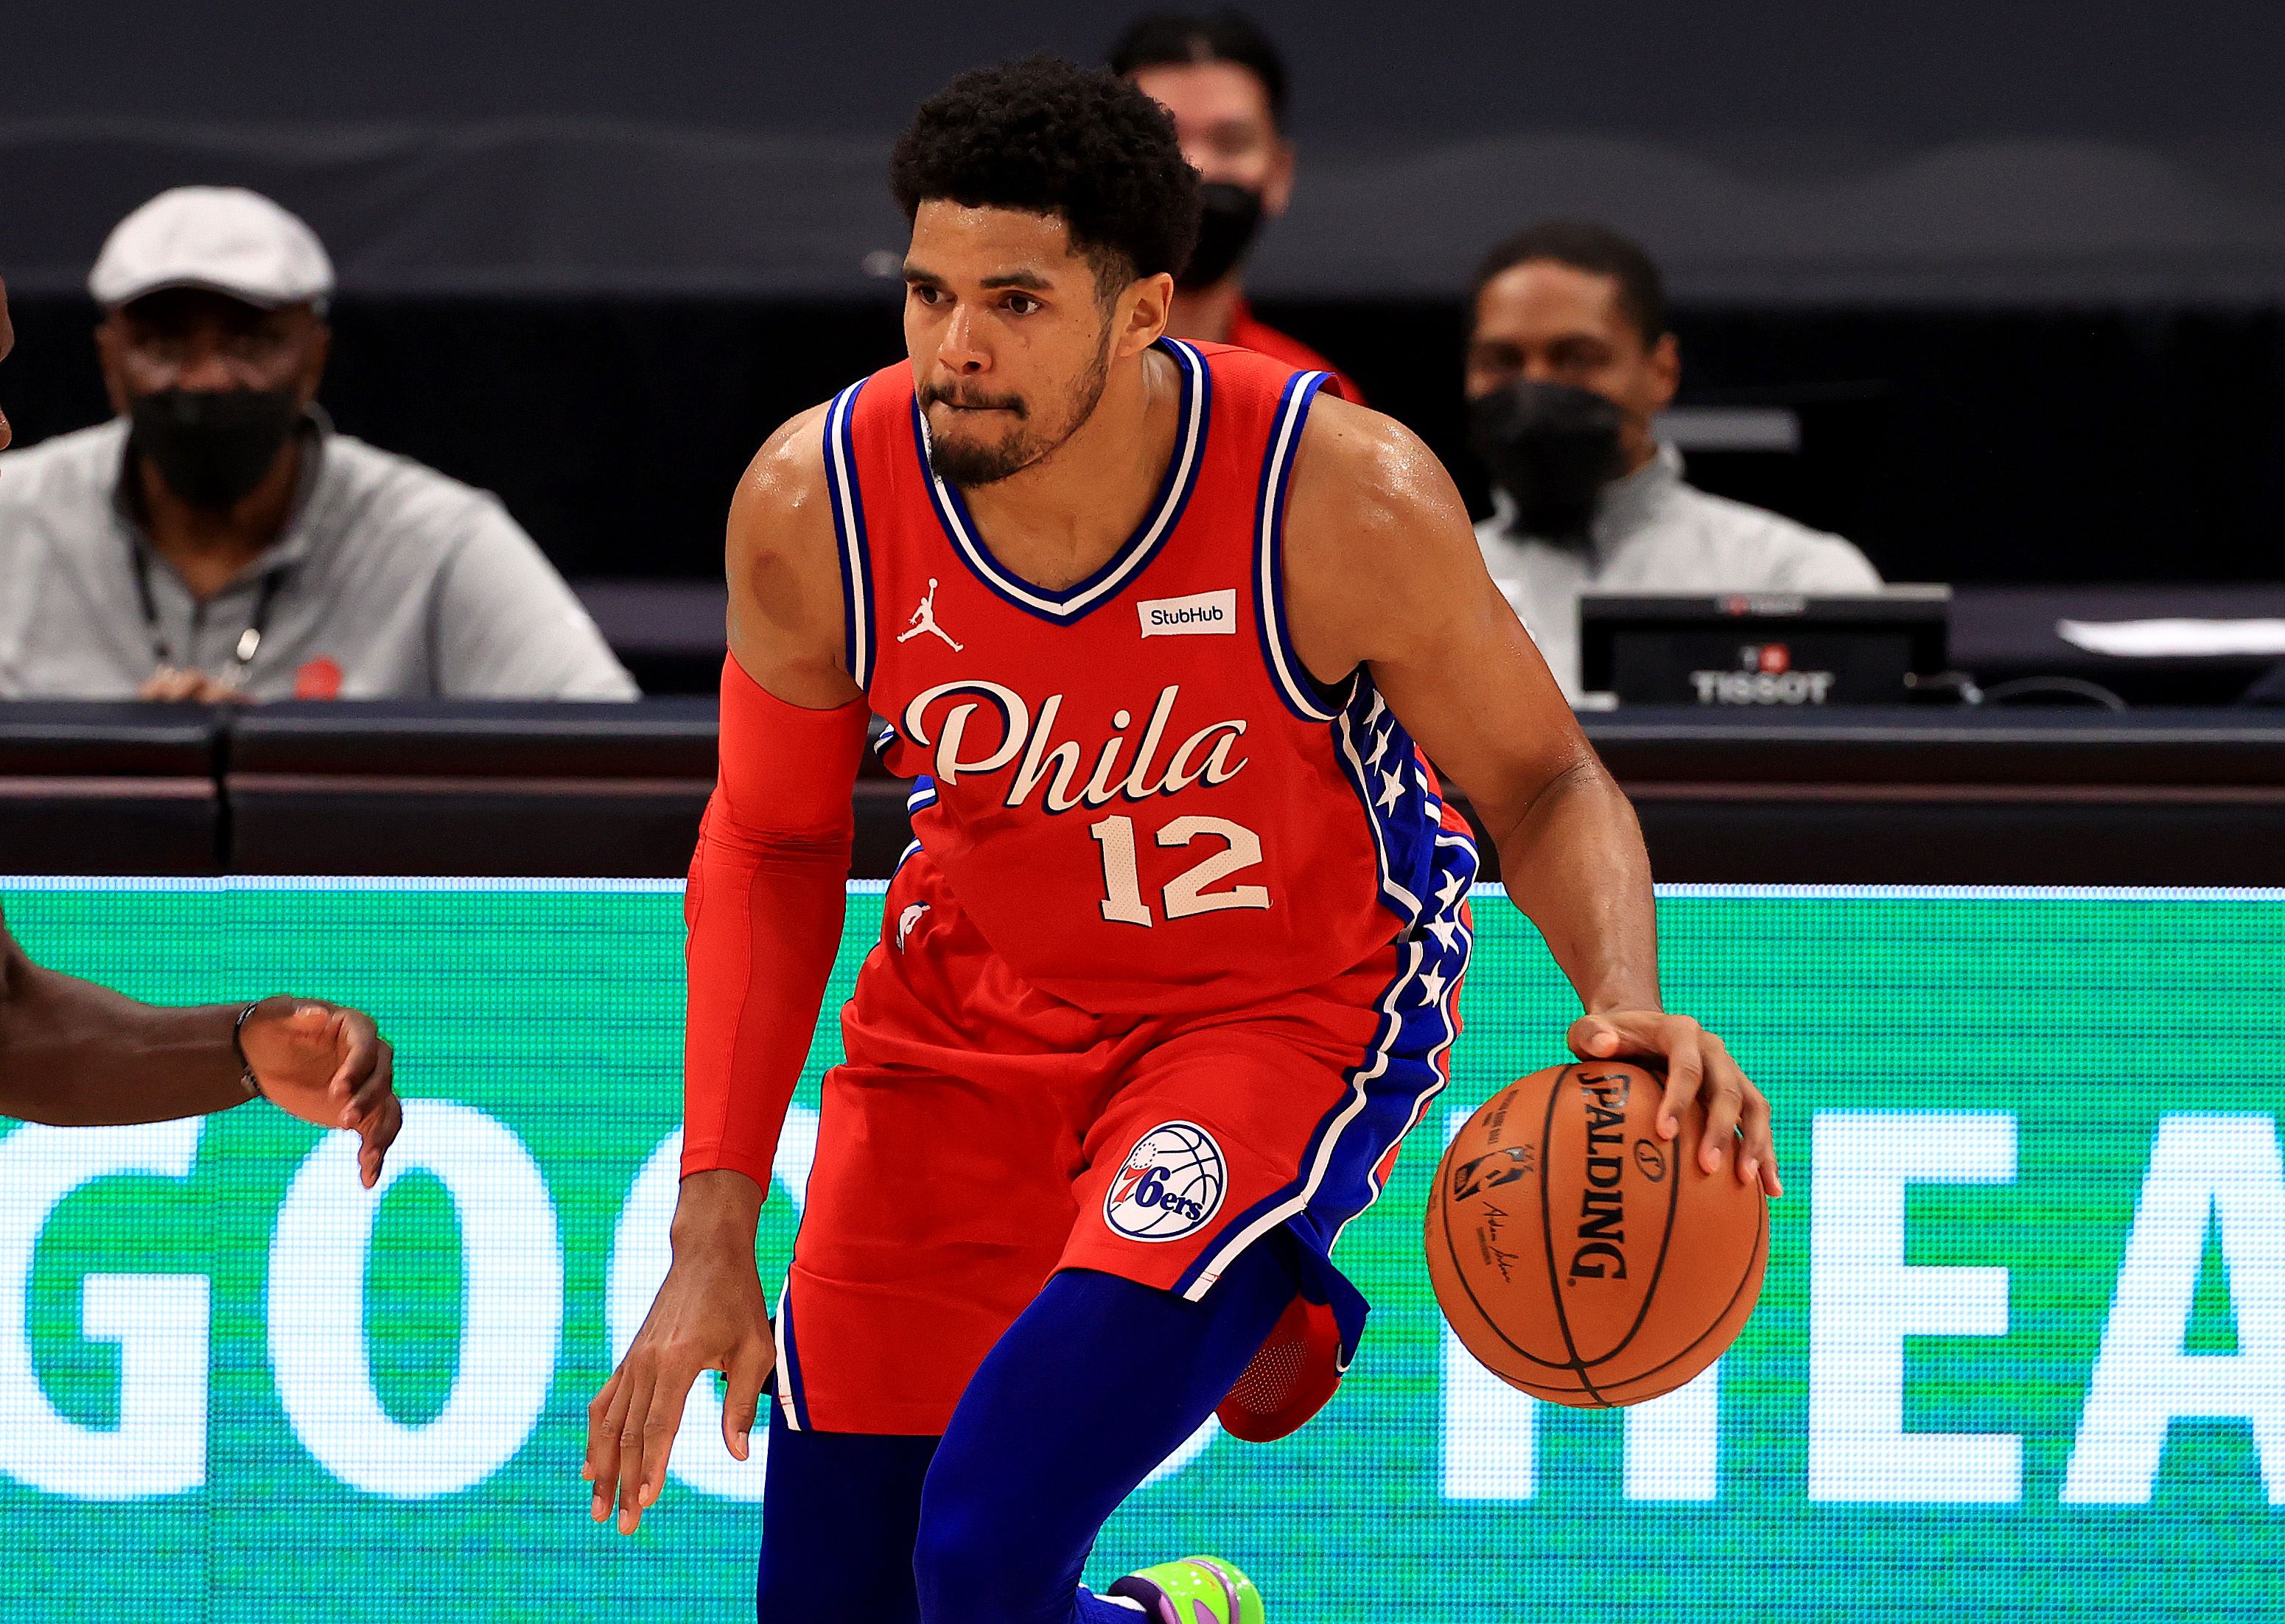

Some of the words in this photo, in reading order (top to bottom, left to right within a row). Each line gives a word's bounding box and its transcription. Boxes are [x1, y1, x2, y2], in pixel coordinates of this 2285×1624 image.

[1151, 605, 1223, 626] StubHub
[904, 680, 1249, 813] Phila
[1090, 815, 1271, 928] 12
[1113, 1165, 1203, 1221] 76ers
[1571, 1072, 1631, 1281] SPALDING
